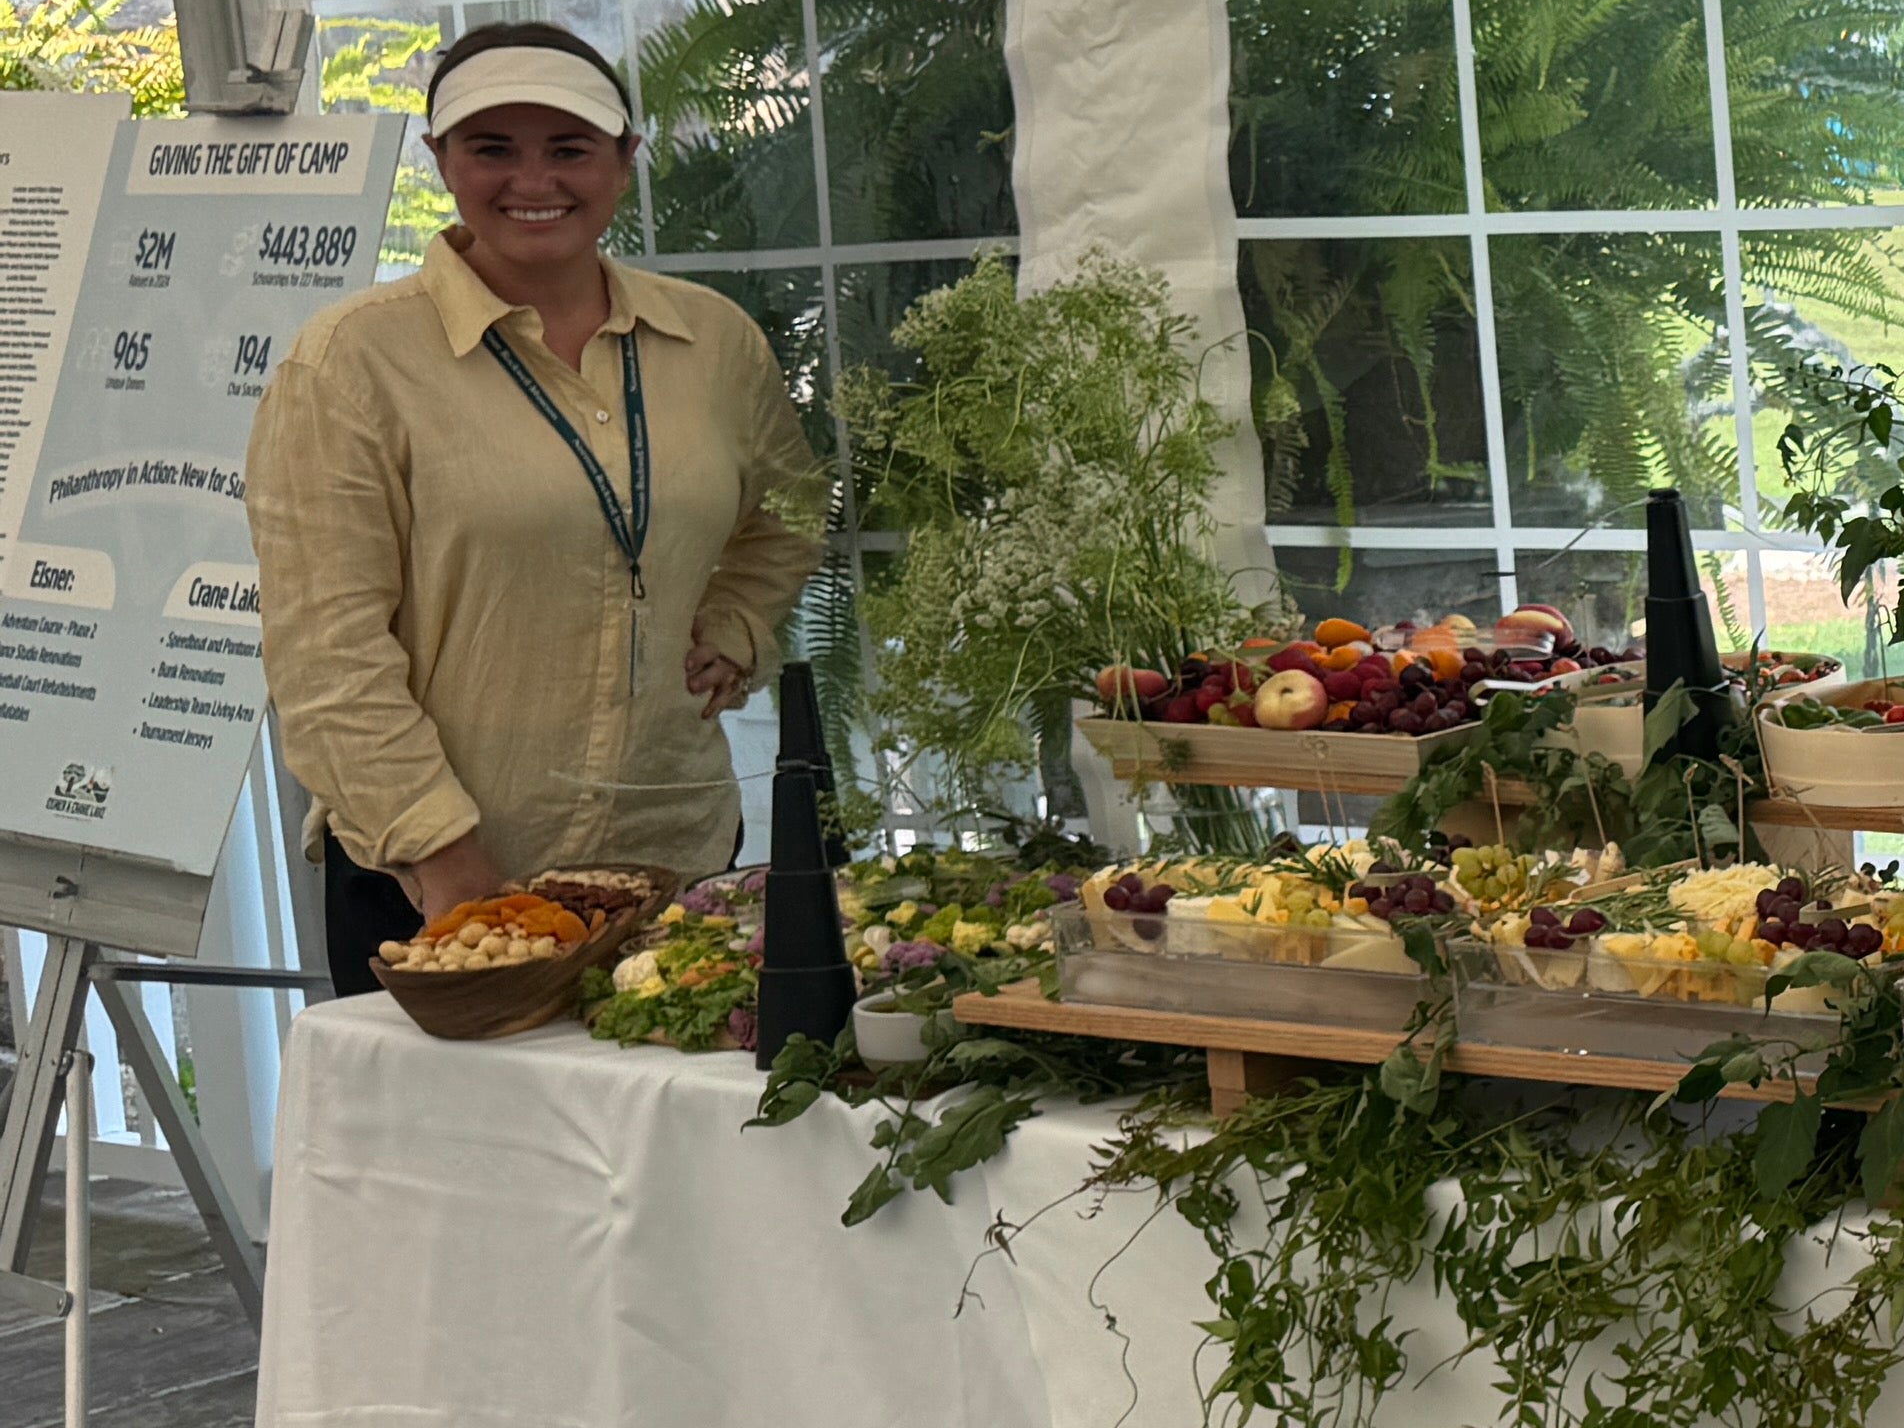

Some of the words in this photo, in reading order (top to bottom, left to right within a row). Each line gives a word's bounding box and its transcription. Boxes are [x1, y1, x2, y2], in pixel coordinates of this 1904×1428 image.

[149, 144, 202, 175] GIVING
[205, 143, 237, 175] THE
[236, 142, 275, 175] GIFT
[274, 142, 299, 174] OF
[298, 141, 349, 174] CAMP
[135, 228, 176, 270] $2M
[259, 222, 357, 270] $443,889
[114, 330, 152, 371] 965
[233, 335, 272, 376] 194
[49, 467, 126, 504] Philanthropy
[126, 462, 139, 485] in
[178, 461, 209, 488] New
[207, 466, 227, 493] for
[30, 560, 75, 591] Eisner:
[189, 577, 230, 609] Crane
[2, 612, 39, 630] Adventure
[39, 617, 63, 636] Course
[67, 620, 90, 638] Phase
[90, 622, 98, 639] 2
[0, 641, 16, 659] ance
[15, 644, 39, 661] Studio
[39, 646, 82, 668] Renovations
[166, 631, 208, 652] Speedboat
[207, 637, 224, 654] and
[222, 637, 256, 657] Pontoon
[21, 675, 41, 693] Court
[40, 678, 97, 701] Refurbishments
[157, 660, 178, 679] Bunk
[179, 663, 226, 686] Renovations
[148, 691, 191, 714] Leadership
[190, 697, 211, 716] Team
[210, 700, 237, 722] Living
[235, 703, 255, 723] Area
[140, 721, 186, 744] Tournament
[184, 729, 214, 751] Jerseys
